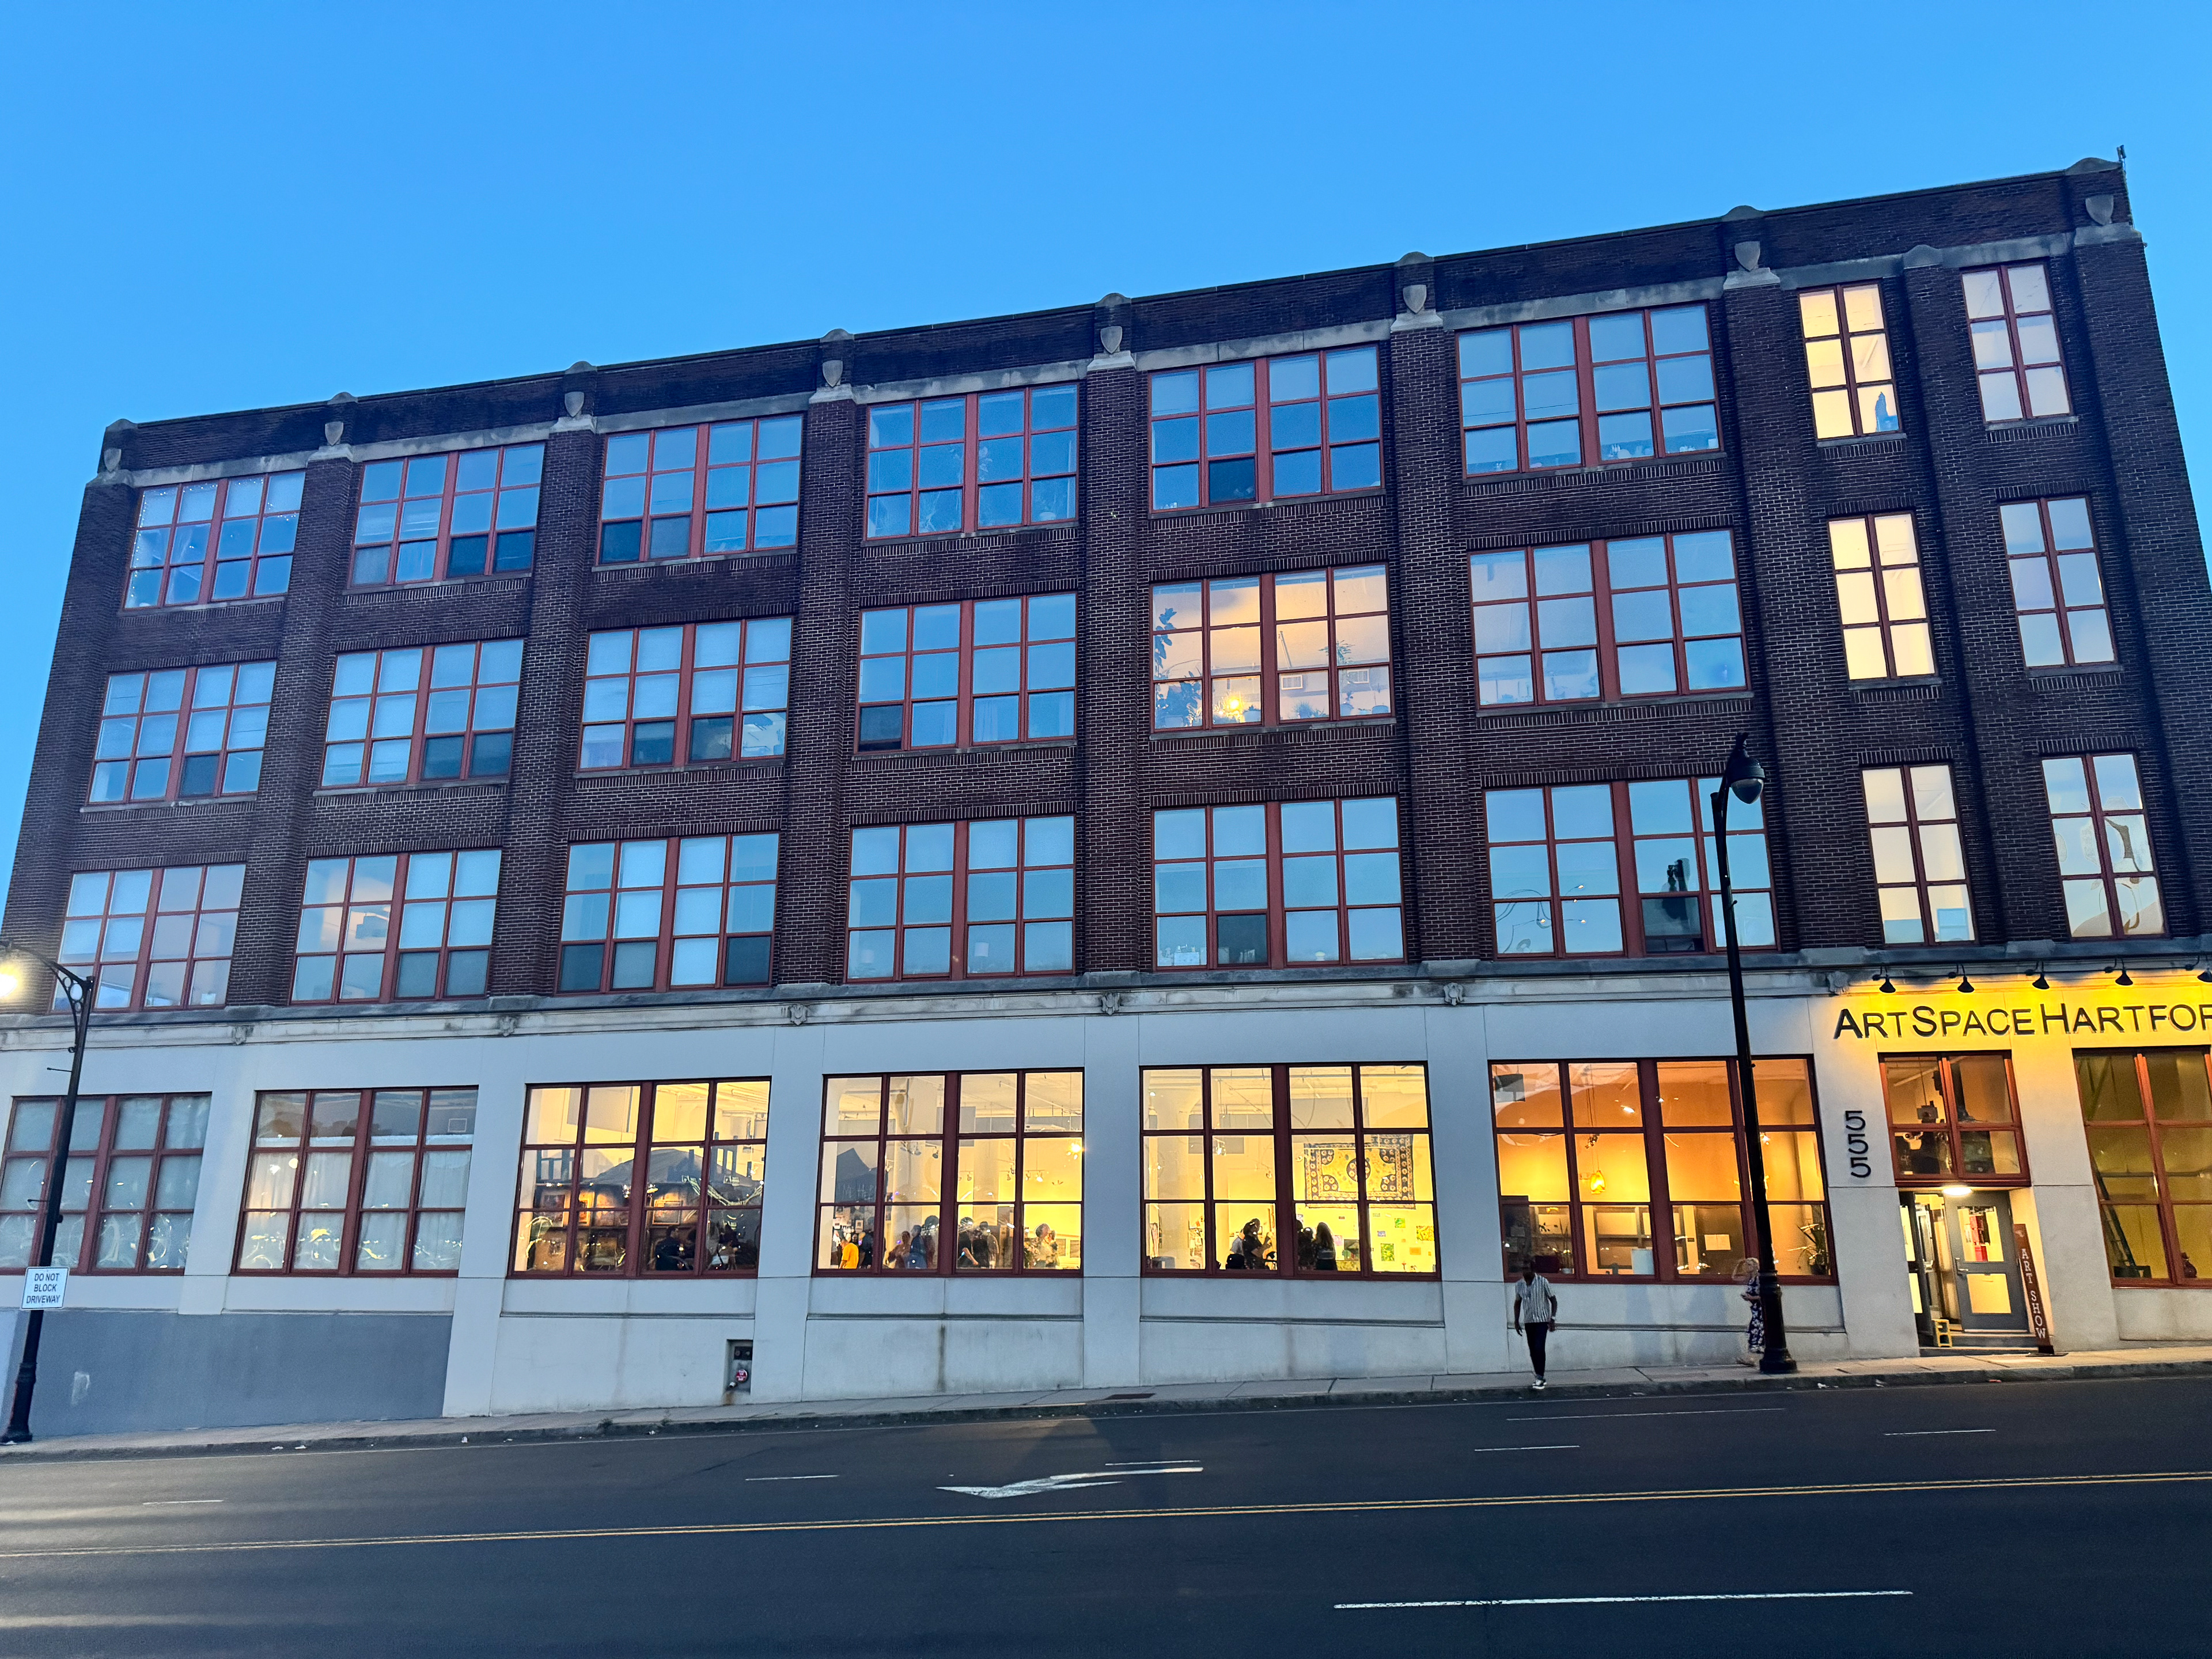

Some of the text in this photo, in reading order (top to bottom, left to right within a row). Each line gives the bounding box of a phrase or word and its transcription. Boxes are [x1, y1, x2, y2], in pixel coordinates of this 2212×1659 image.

[1845, 1110, 1871, 1178] 555
[46, 1273, 60, 1281] NOT
[34, 1284, 57, 1292] BLOCK
[2021, 1248, 2046, 1339] ART SHOW
[26, 1295, 60, 1304] DRIVEWAY
